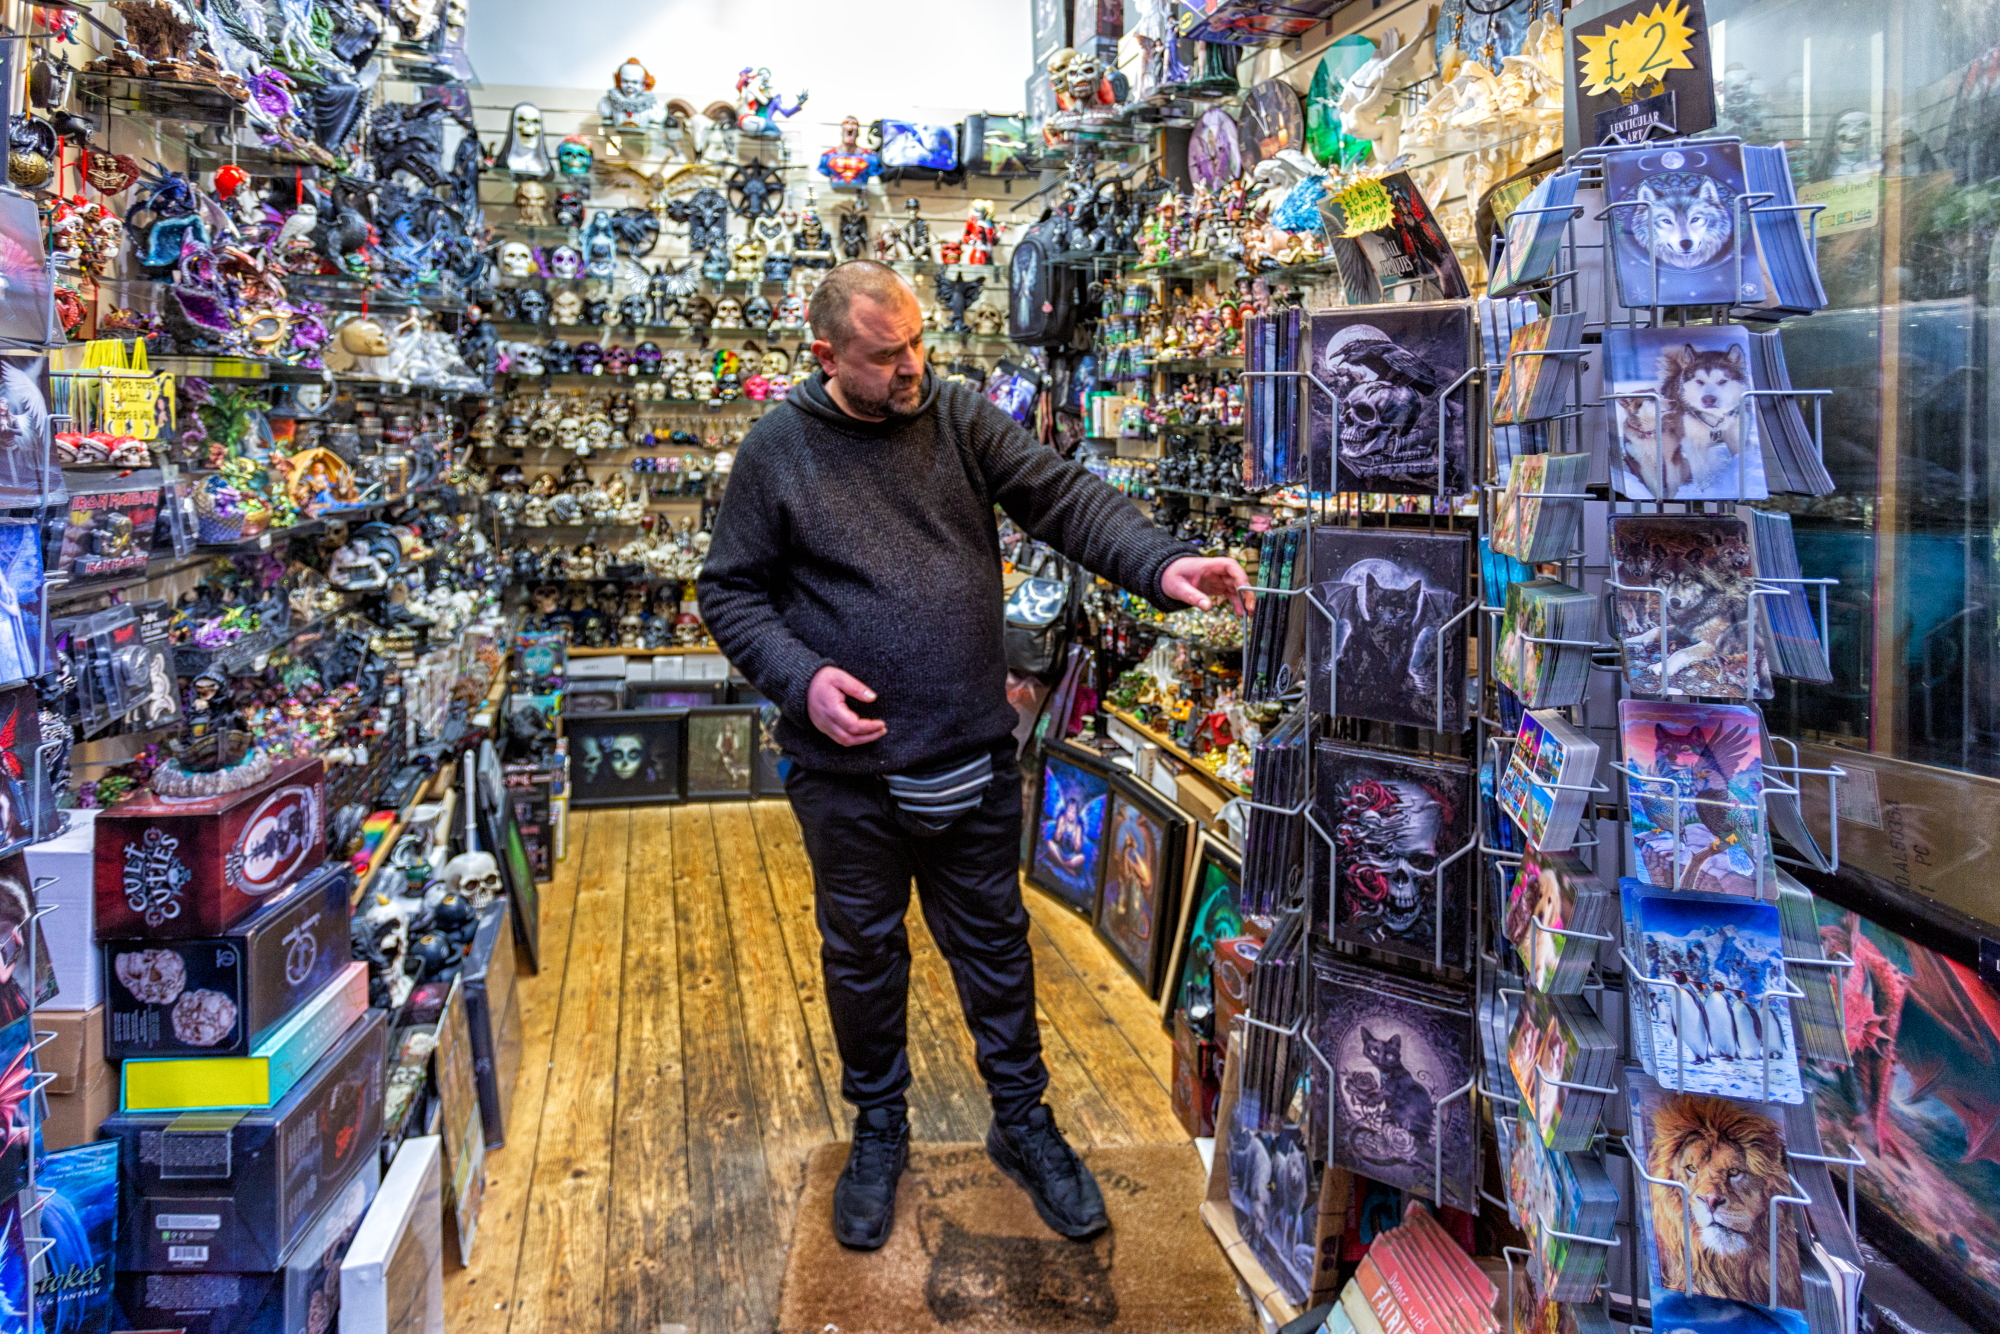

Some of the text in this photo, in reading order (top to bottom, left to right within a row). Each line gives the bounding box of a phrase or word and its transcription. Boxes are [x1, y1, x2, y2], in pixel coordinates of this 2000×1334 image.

[1628, 104, 1639, 117] 3D
[1610, 111, 1659, 134] LENTICULAR
[1627, 129, 1644, 143] ART
[1803, 180, 1873, 202] Accepted here
[72, 491, 159, 513] IRON MAIDEN
[123, 842, 148, 912] CULT
[145, 834, 181, 919] CUTIES
[57, 1287, 100, 1303] FANTASY
